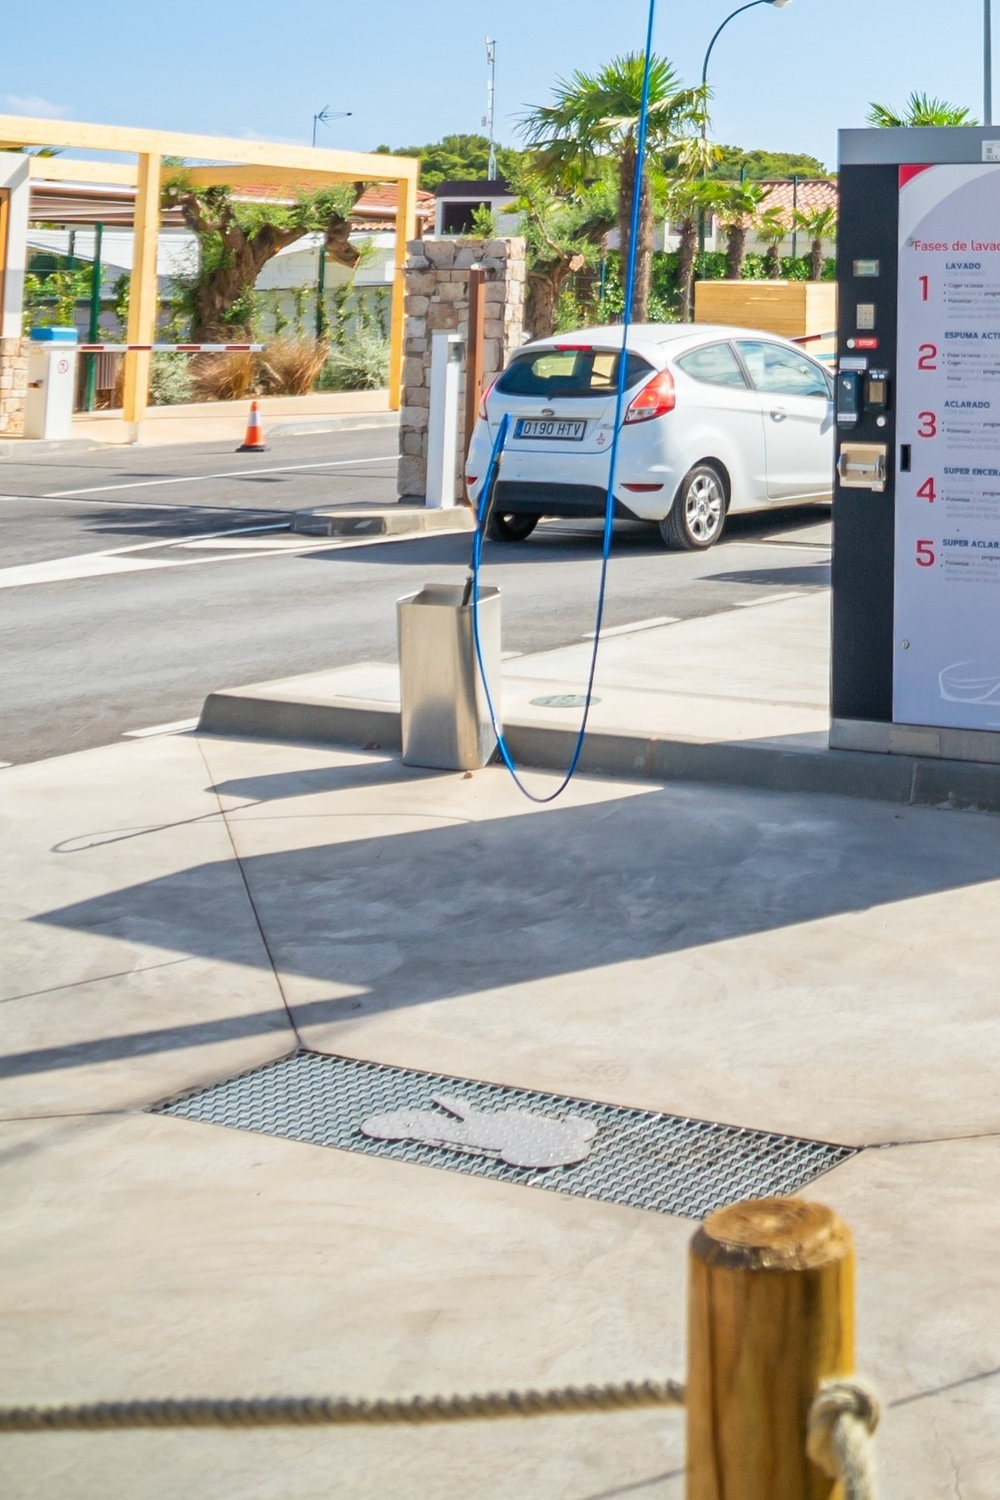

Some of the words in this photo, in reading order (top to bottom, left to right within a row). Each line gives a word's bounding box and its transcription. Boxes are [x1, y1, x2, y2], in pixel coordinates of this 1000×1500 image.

[914, 240, 948, 252] Fases
[952, 240, 968, 252] de
[945, 262, 981, 270] LAVADO
[918, 275, 929, 301] 1
[944, 332, 979, 340] ESPUMA
[918, 344, 937, 371] 2
[944, 400, 990, 409] ACLARADO
[523, 422, 554, 435] 0190
[556, 424, 582, 436] HTV
[917, 412, 936, 438] 3
[943, 467, 970, 475] SUPER
[916, 477, 936, 503] 4
[942, 539, 969, 547] SUPER
[916, 540, 935, 567] 5
